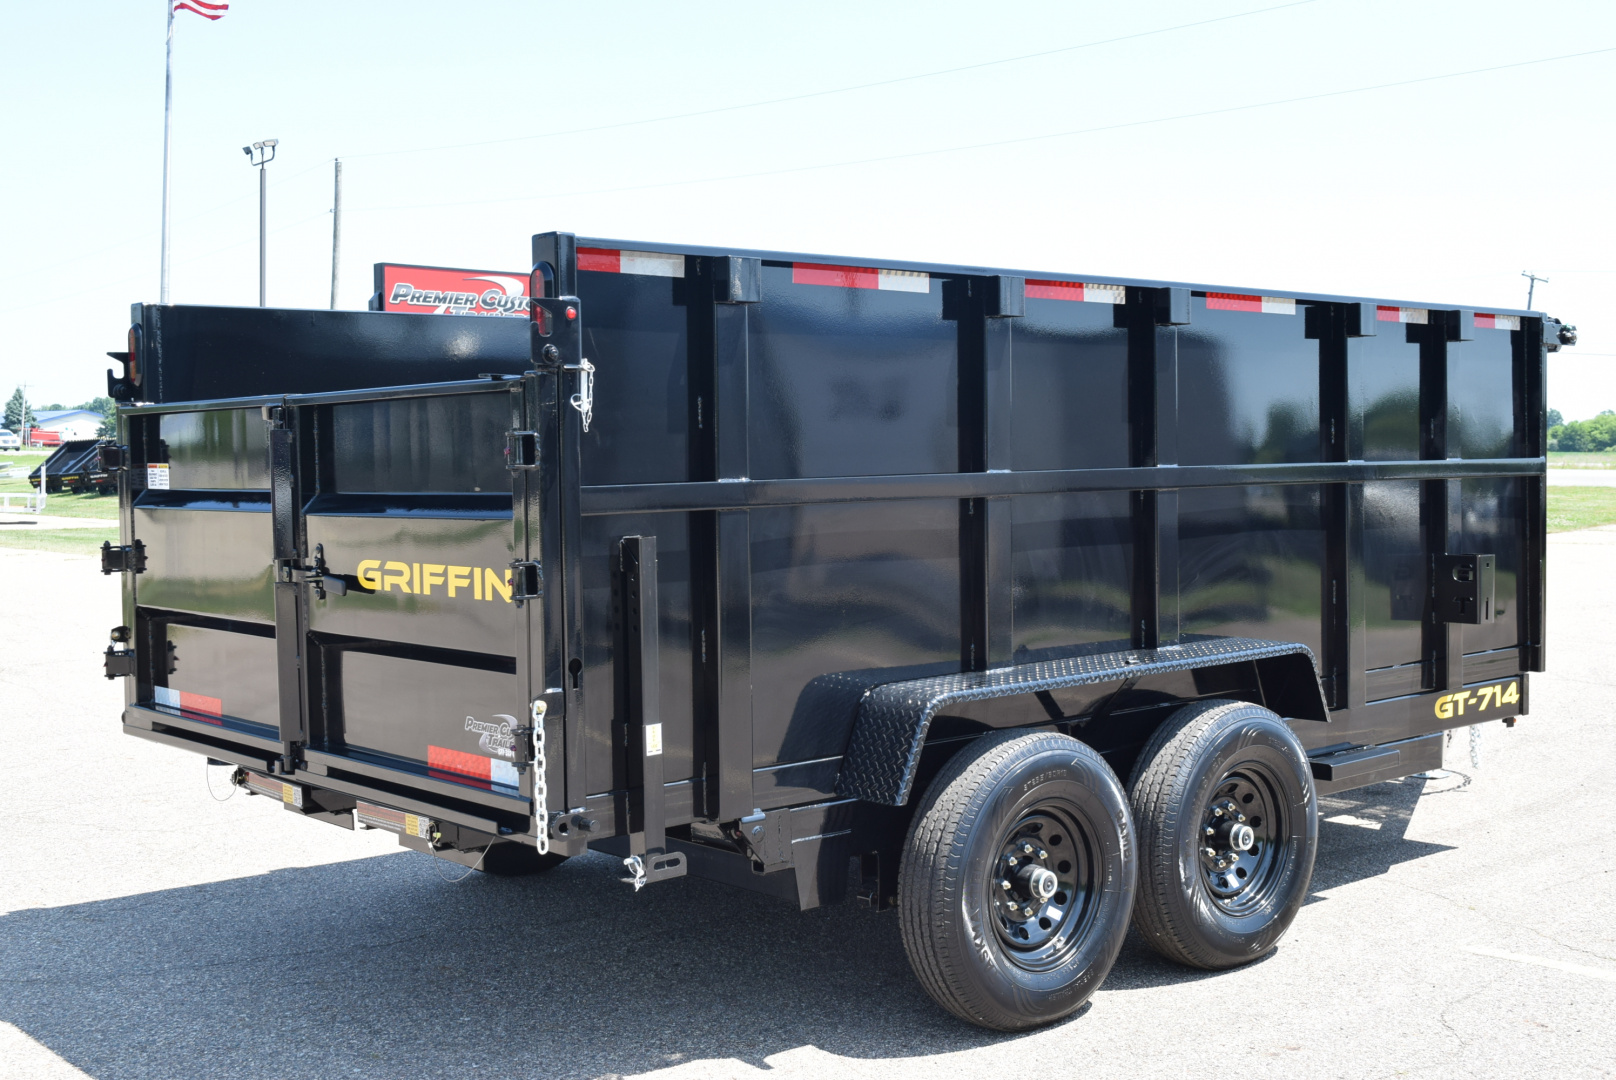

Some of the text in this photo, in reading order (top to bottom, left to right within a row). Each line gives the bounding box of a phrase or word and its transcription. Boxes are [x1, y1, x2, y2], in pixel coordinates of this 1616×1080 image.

[390, 283, 478, 307] PREMIER
[357, 559, 512, 603] GRIFFIN
[1434, 681, 1520, 719] GT-714
[465, 716, 499, 735] PREMIER
